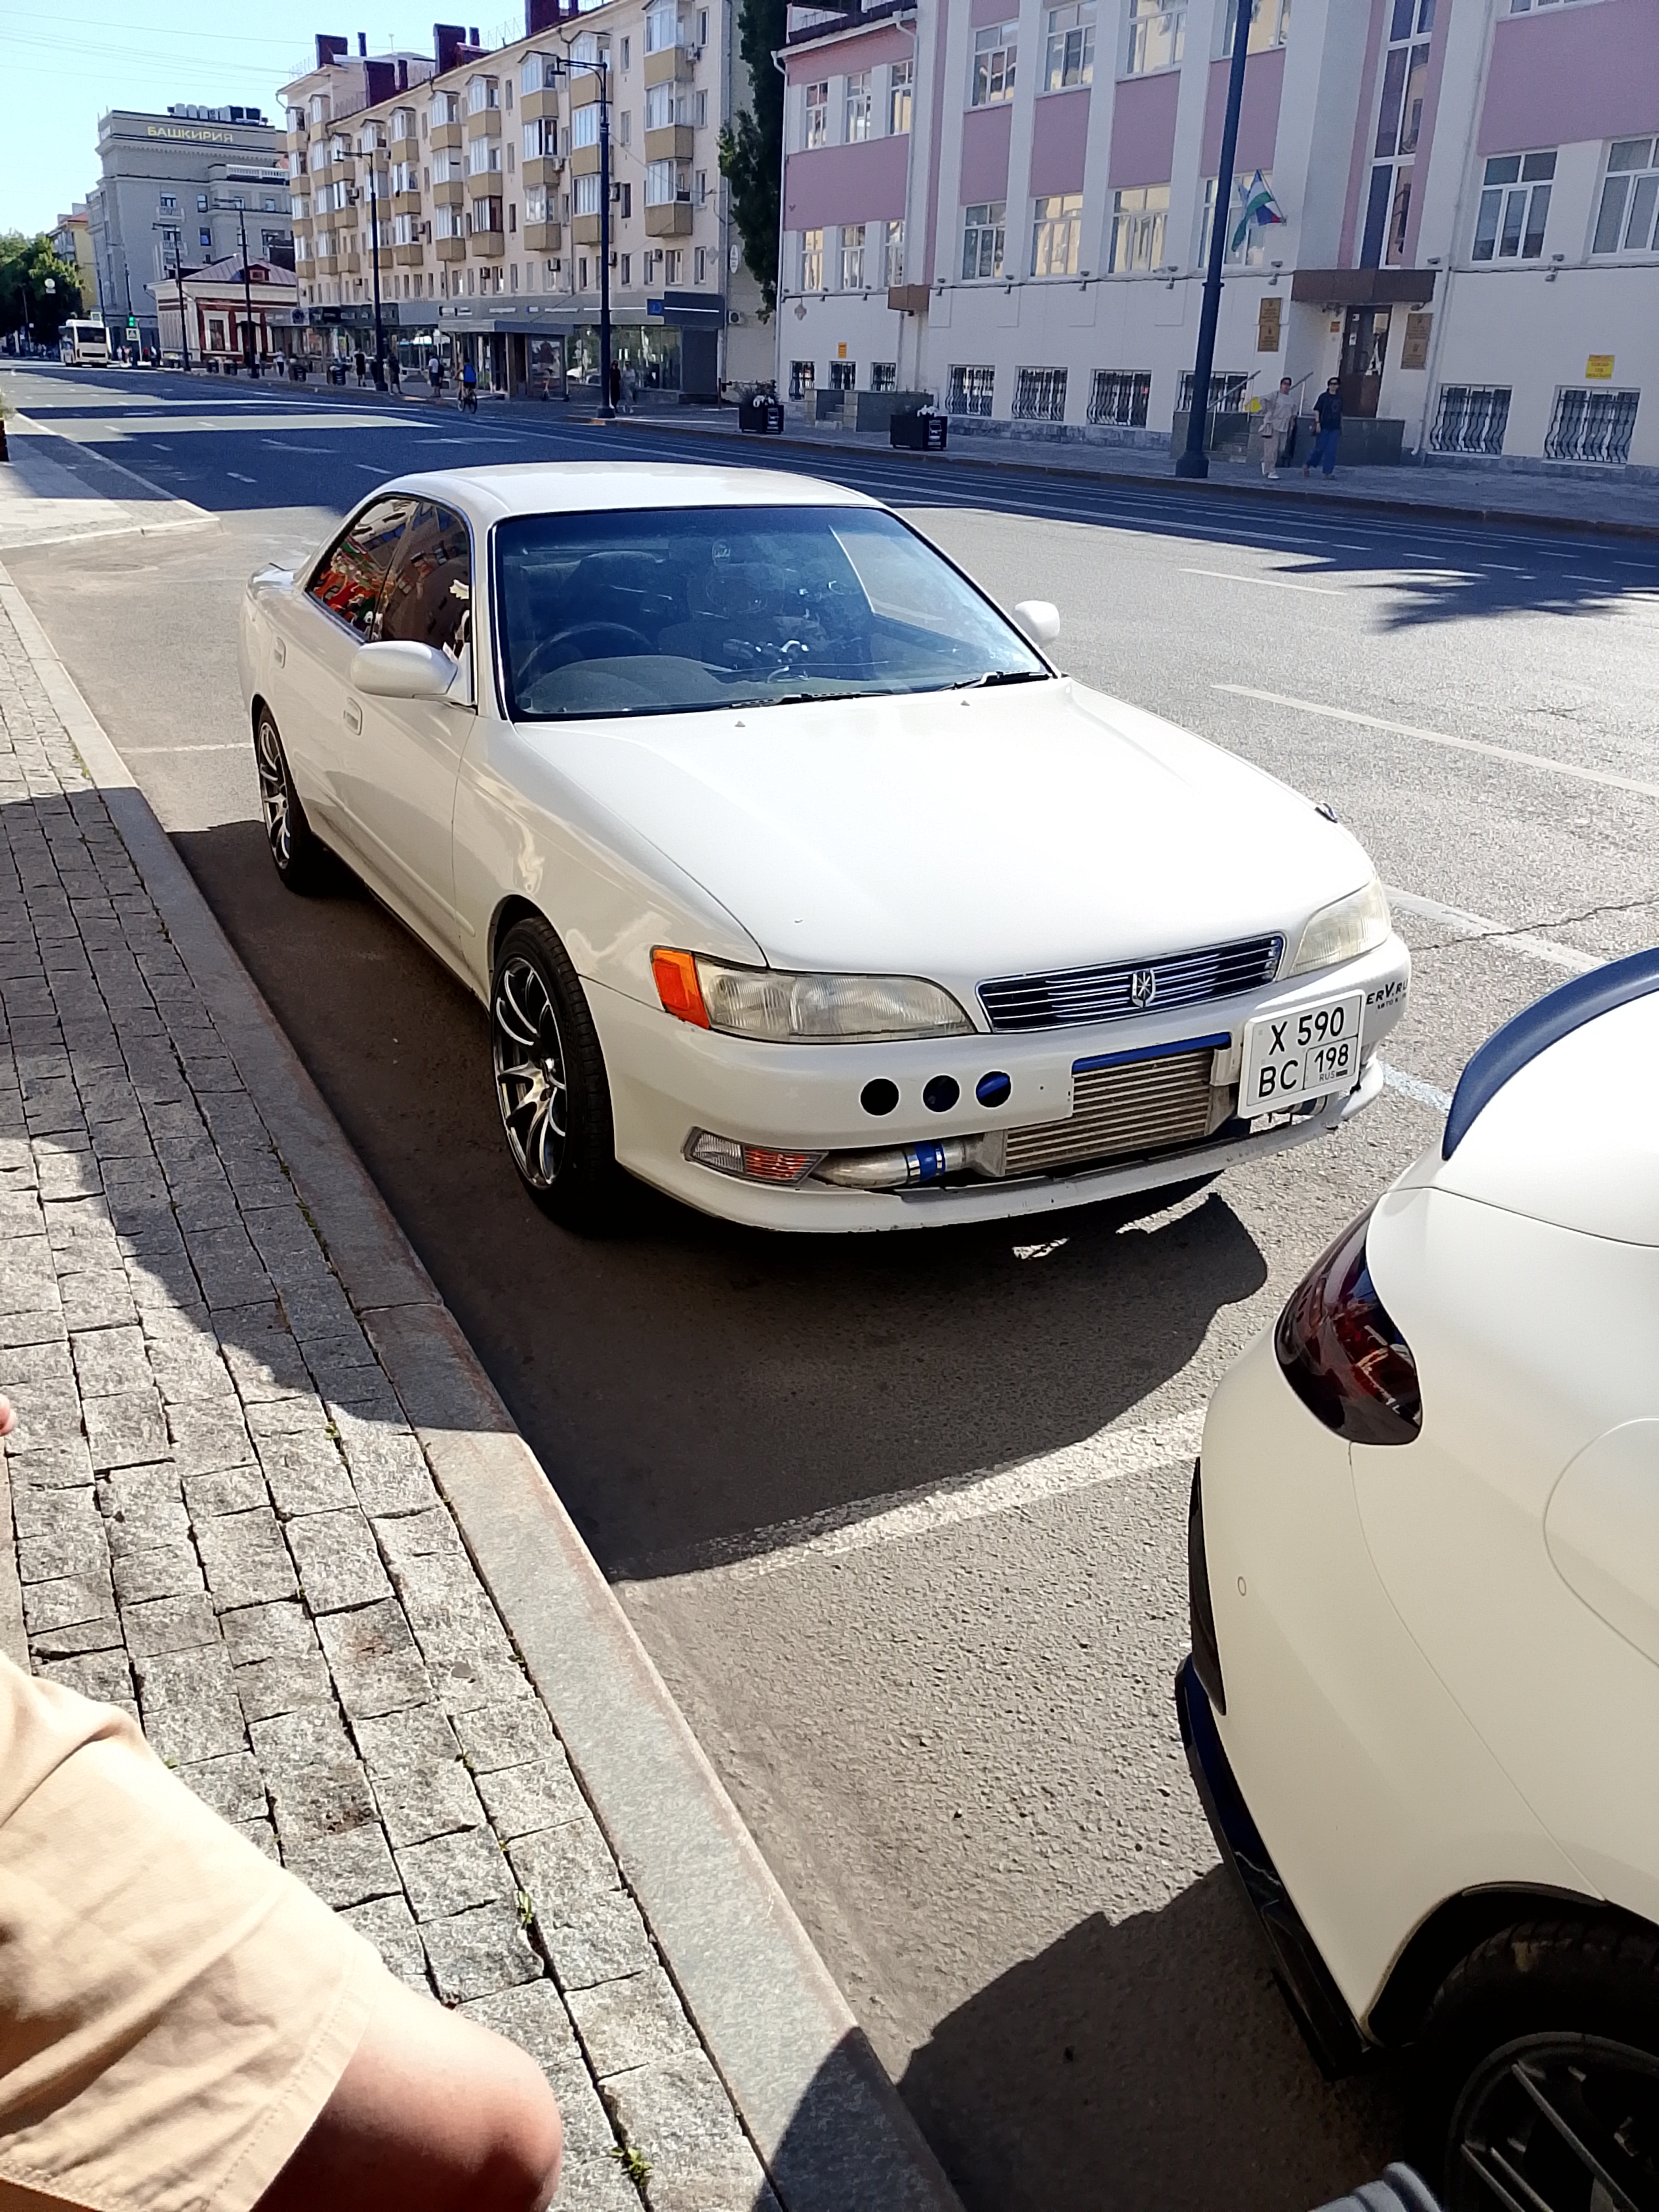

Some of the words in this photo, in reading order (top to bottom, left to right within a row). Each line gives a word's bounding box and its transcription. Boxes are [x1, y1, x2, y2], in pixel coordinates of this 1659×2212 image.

[147, 126, 233, 143] БАШКИРИЯ
[1297, 1006, 1345, 1046] 590
[1313, 1043, 1349, 1073] 198
[1319, 1070, 1335, 1082] RUS
